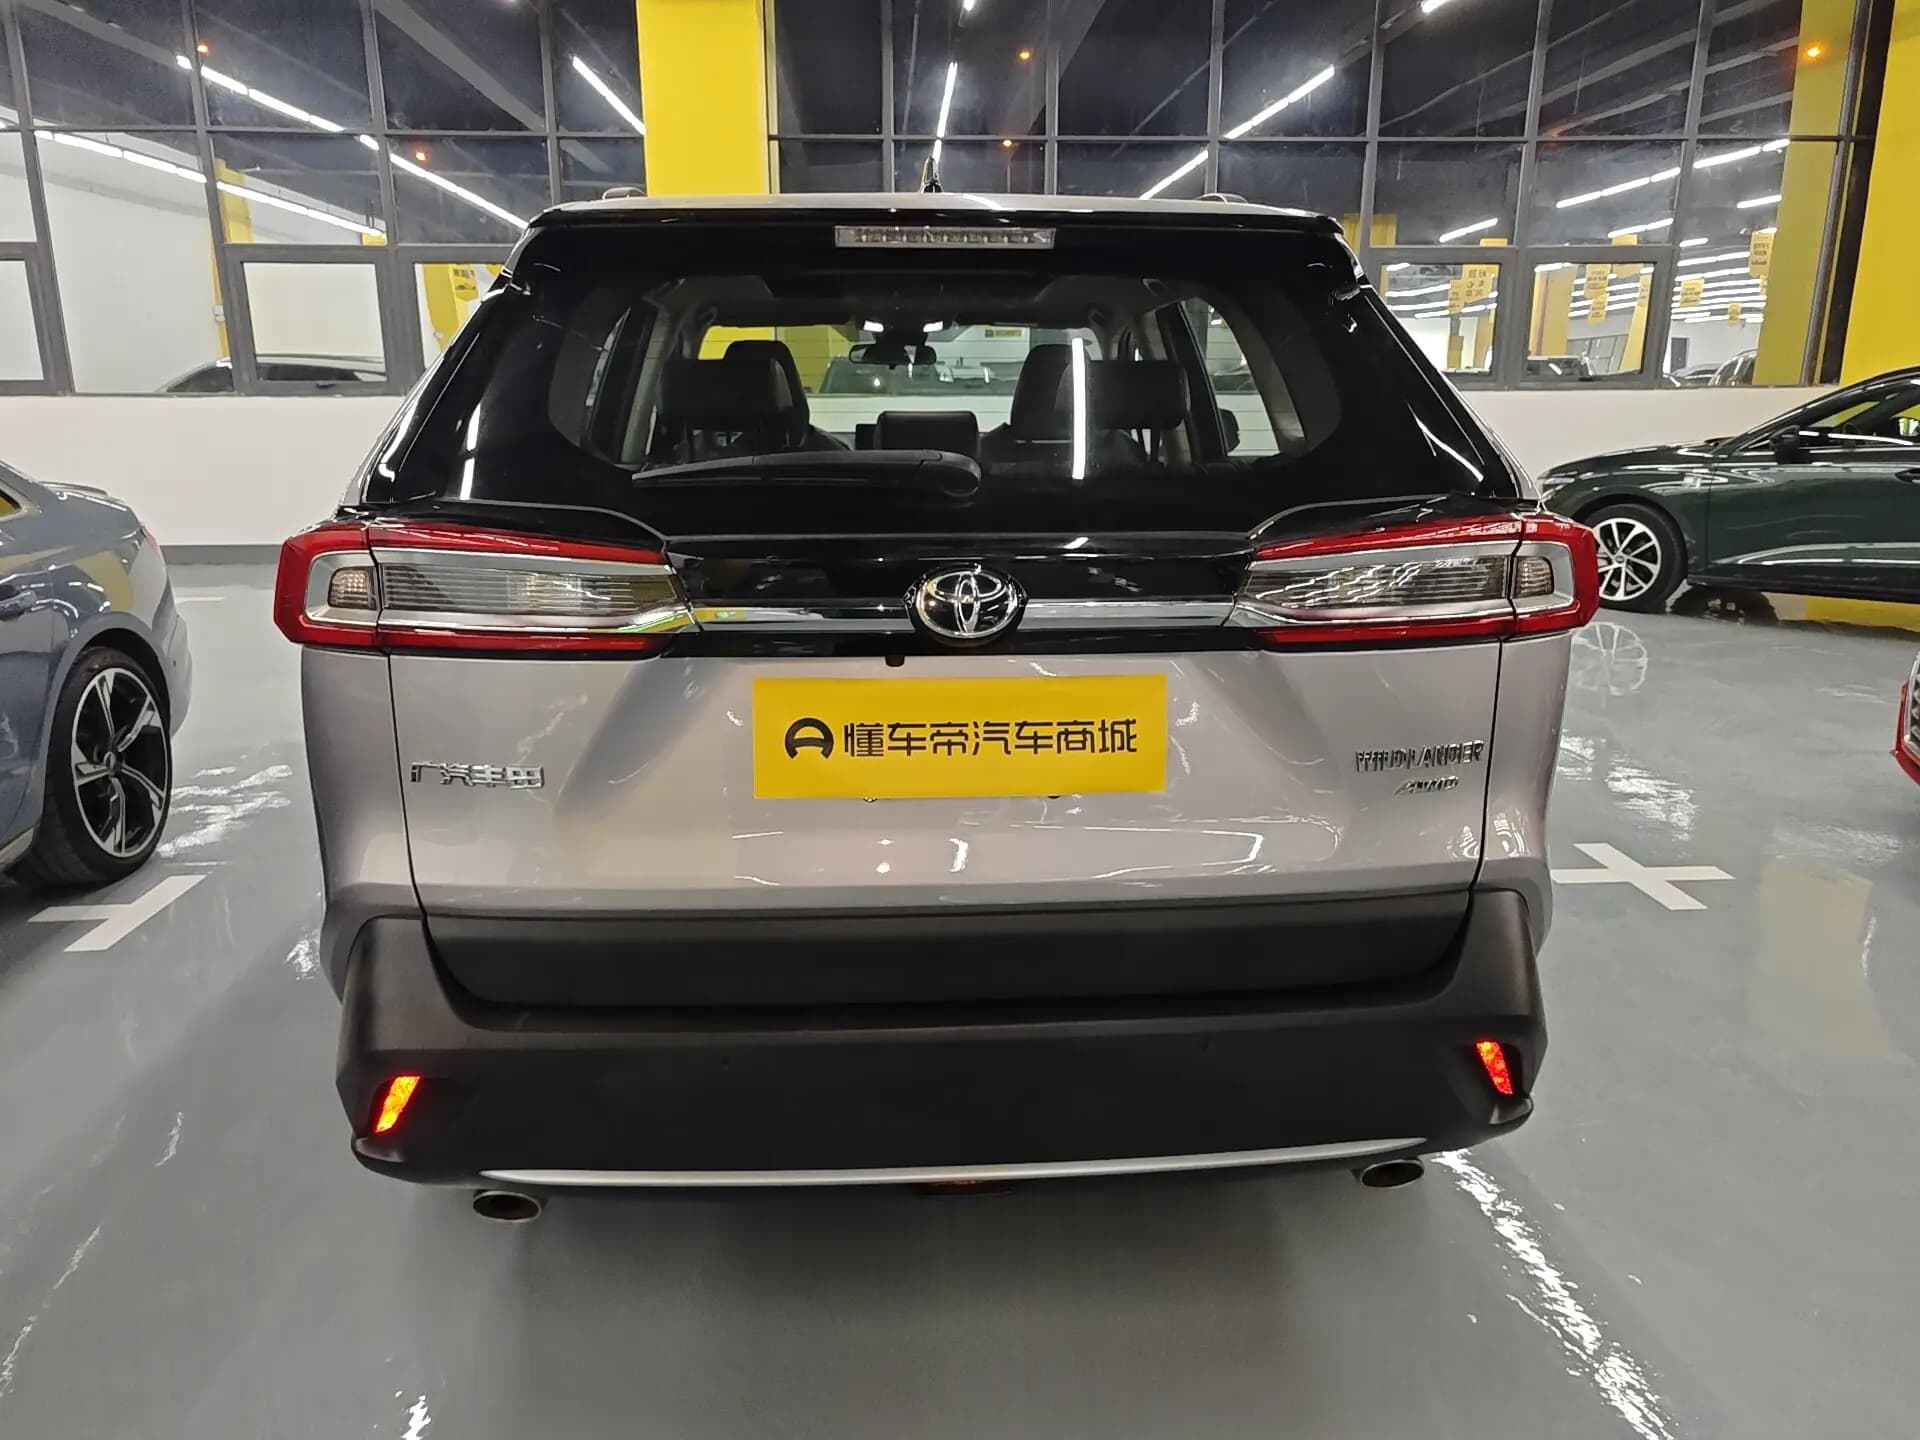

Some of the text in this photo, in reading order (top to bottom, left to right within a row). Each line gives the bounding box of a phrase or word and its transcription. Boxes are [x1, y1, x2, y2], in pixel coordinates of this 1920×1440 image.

[843, 718, 1138, 758] 懂车帝汽车商城
